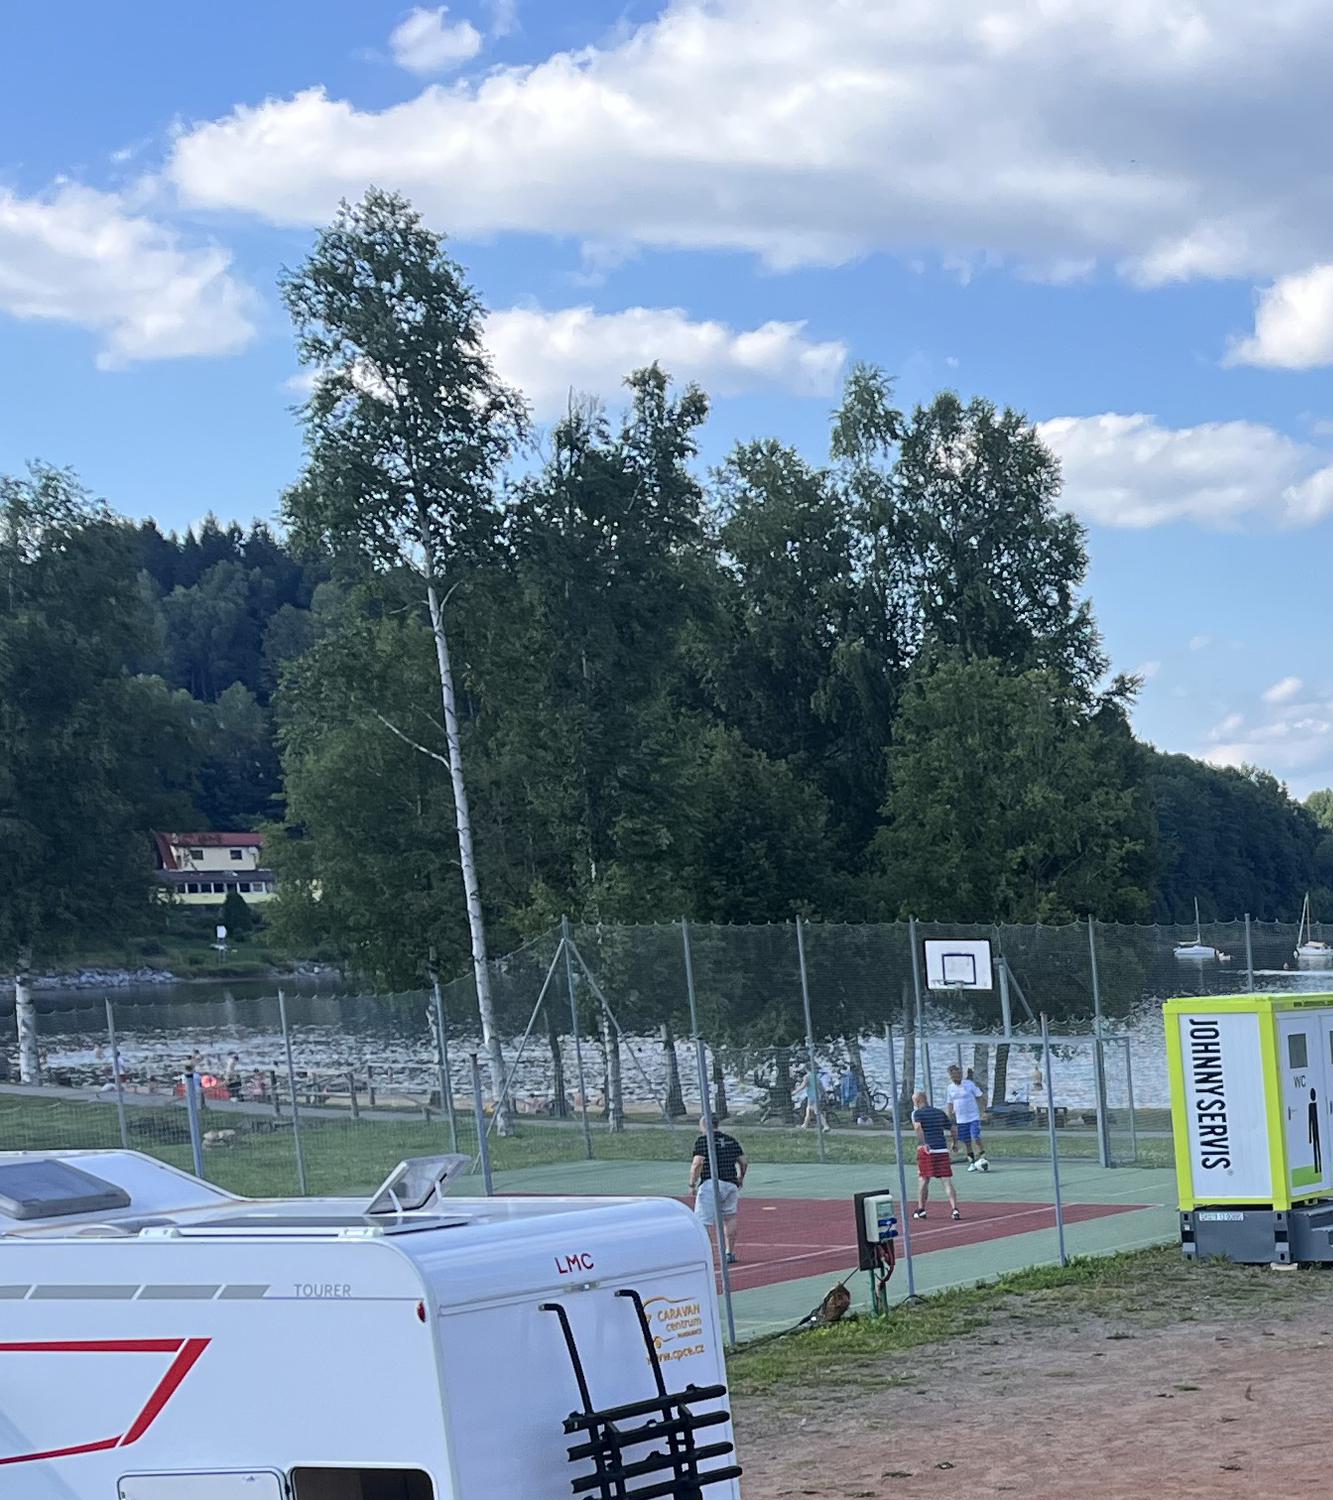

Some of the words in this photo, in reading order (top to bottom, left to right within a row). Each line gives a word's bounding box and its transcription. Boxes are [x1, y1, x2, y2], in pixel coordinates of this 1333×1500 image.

[1293, 1075, 1306, 1088] WC
[555, 1253, 594, 1274] LMC
[294, 1284, 351, 1297] TOURER
[657, 1304, 700, 1321] CARAVAN
